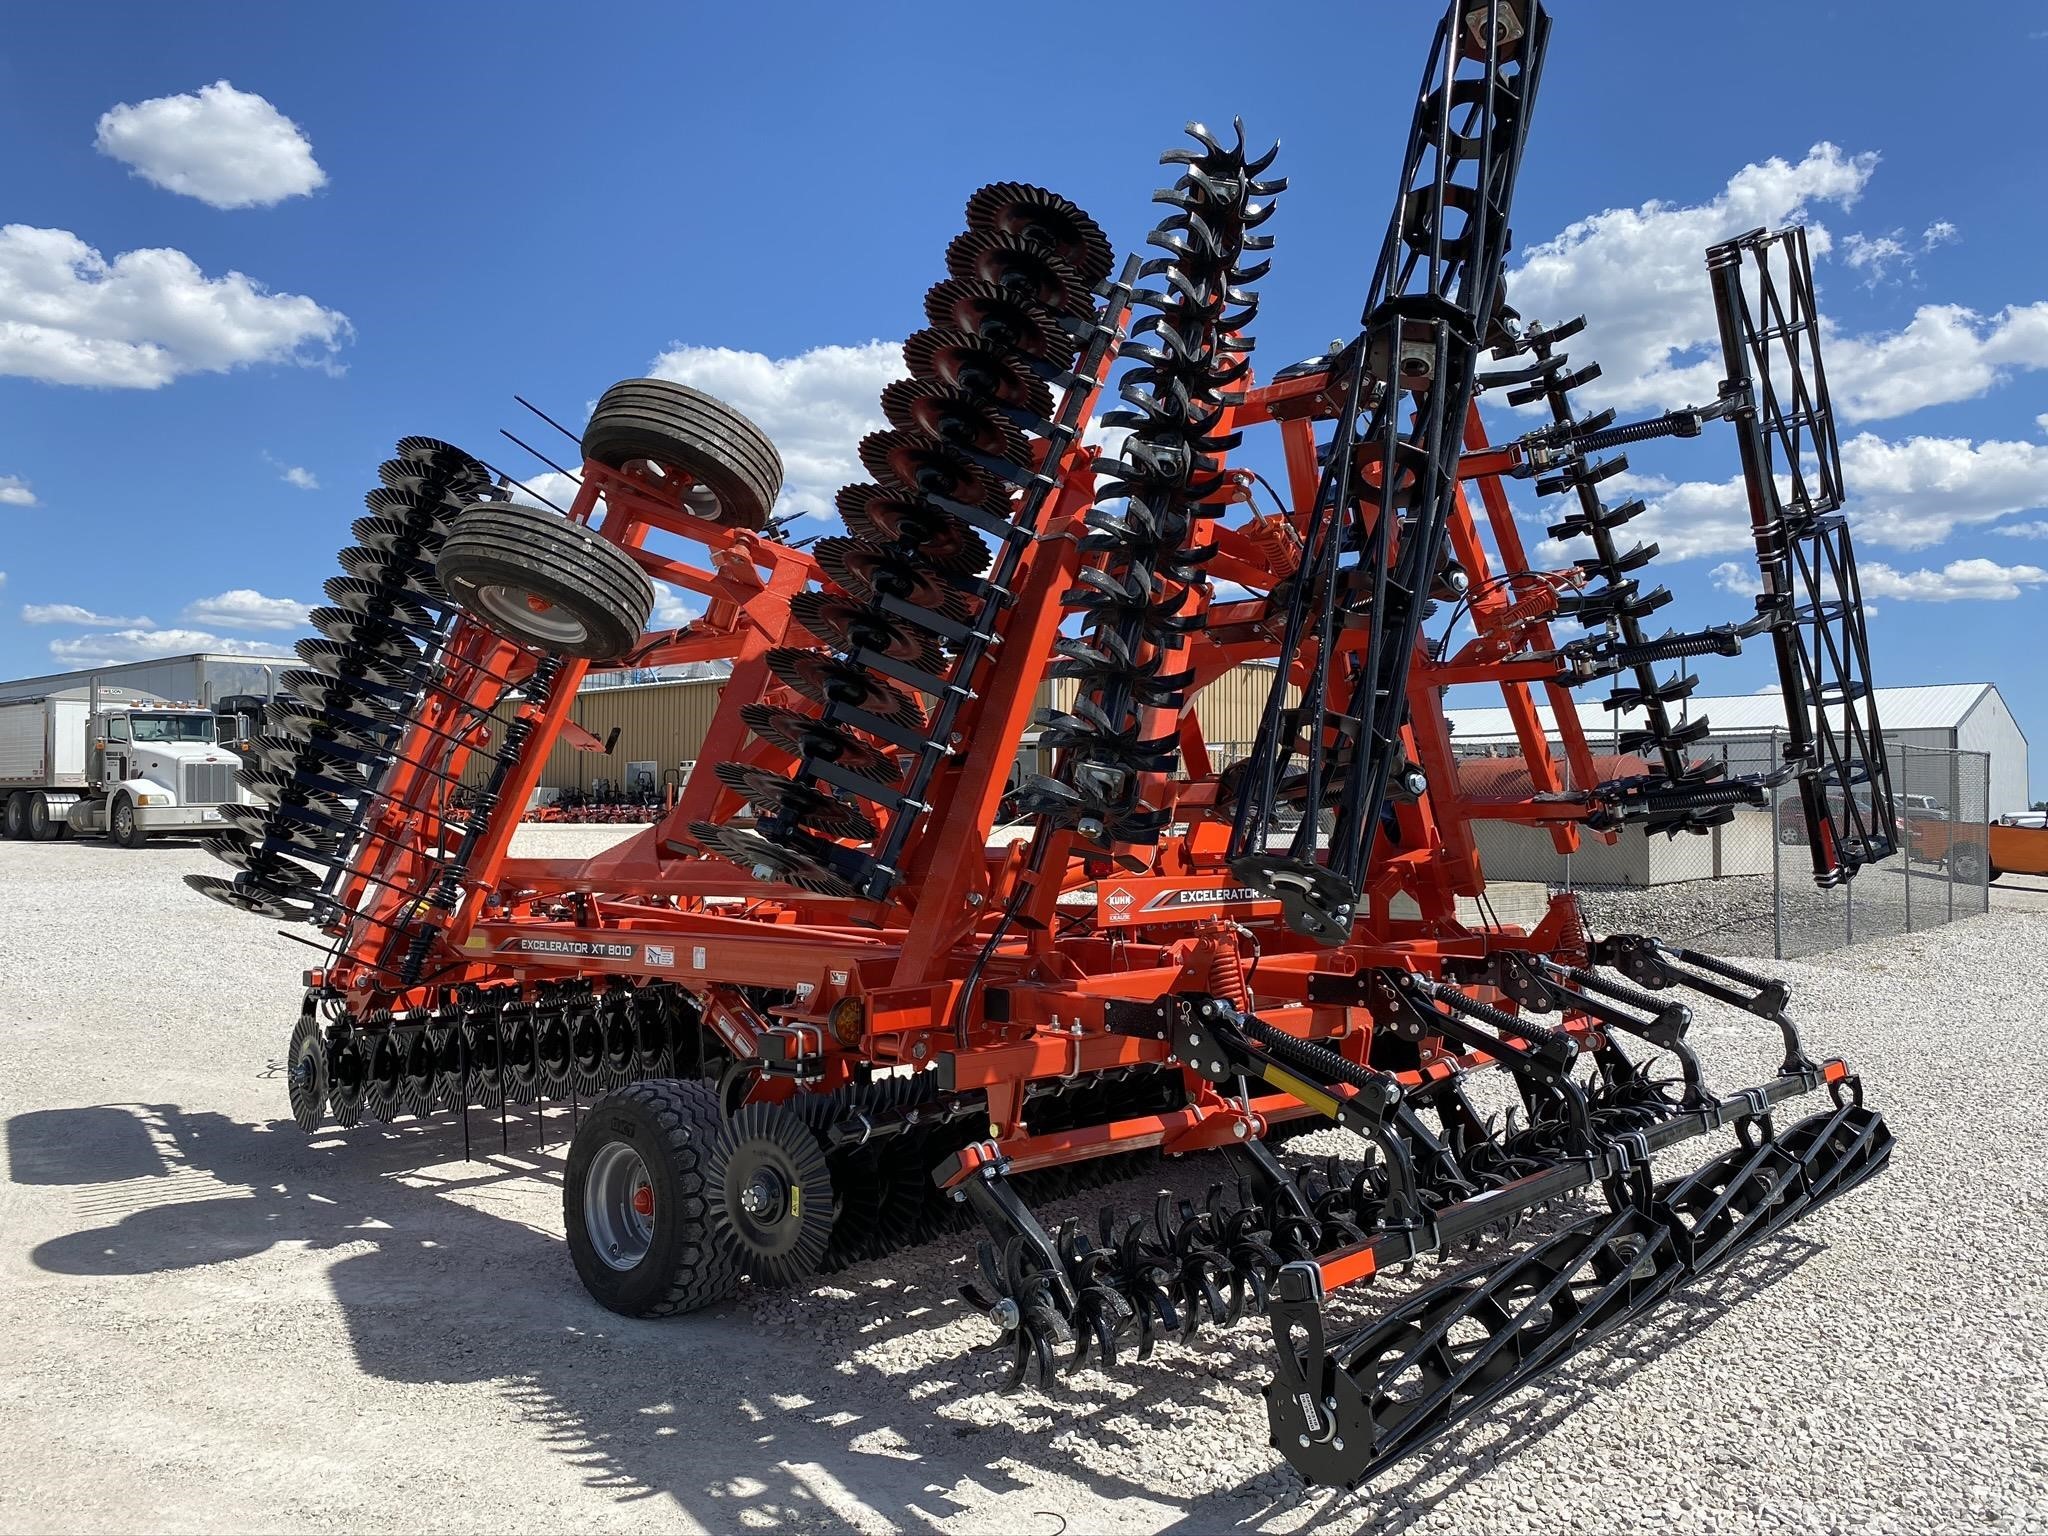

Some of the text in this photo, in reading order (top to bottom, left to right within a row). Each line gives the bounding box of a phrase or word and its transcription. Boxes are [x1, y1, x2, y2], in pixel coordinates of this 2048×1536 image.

[1109, 895, 1131, 905] KUHN
[1180, 888, 1259, 903] EXCELERATOR
[521, 939, 632, 956] EXCELERATOR XT 8010
